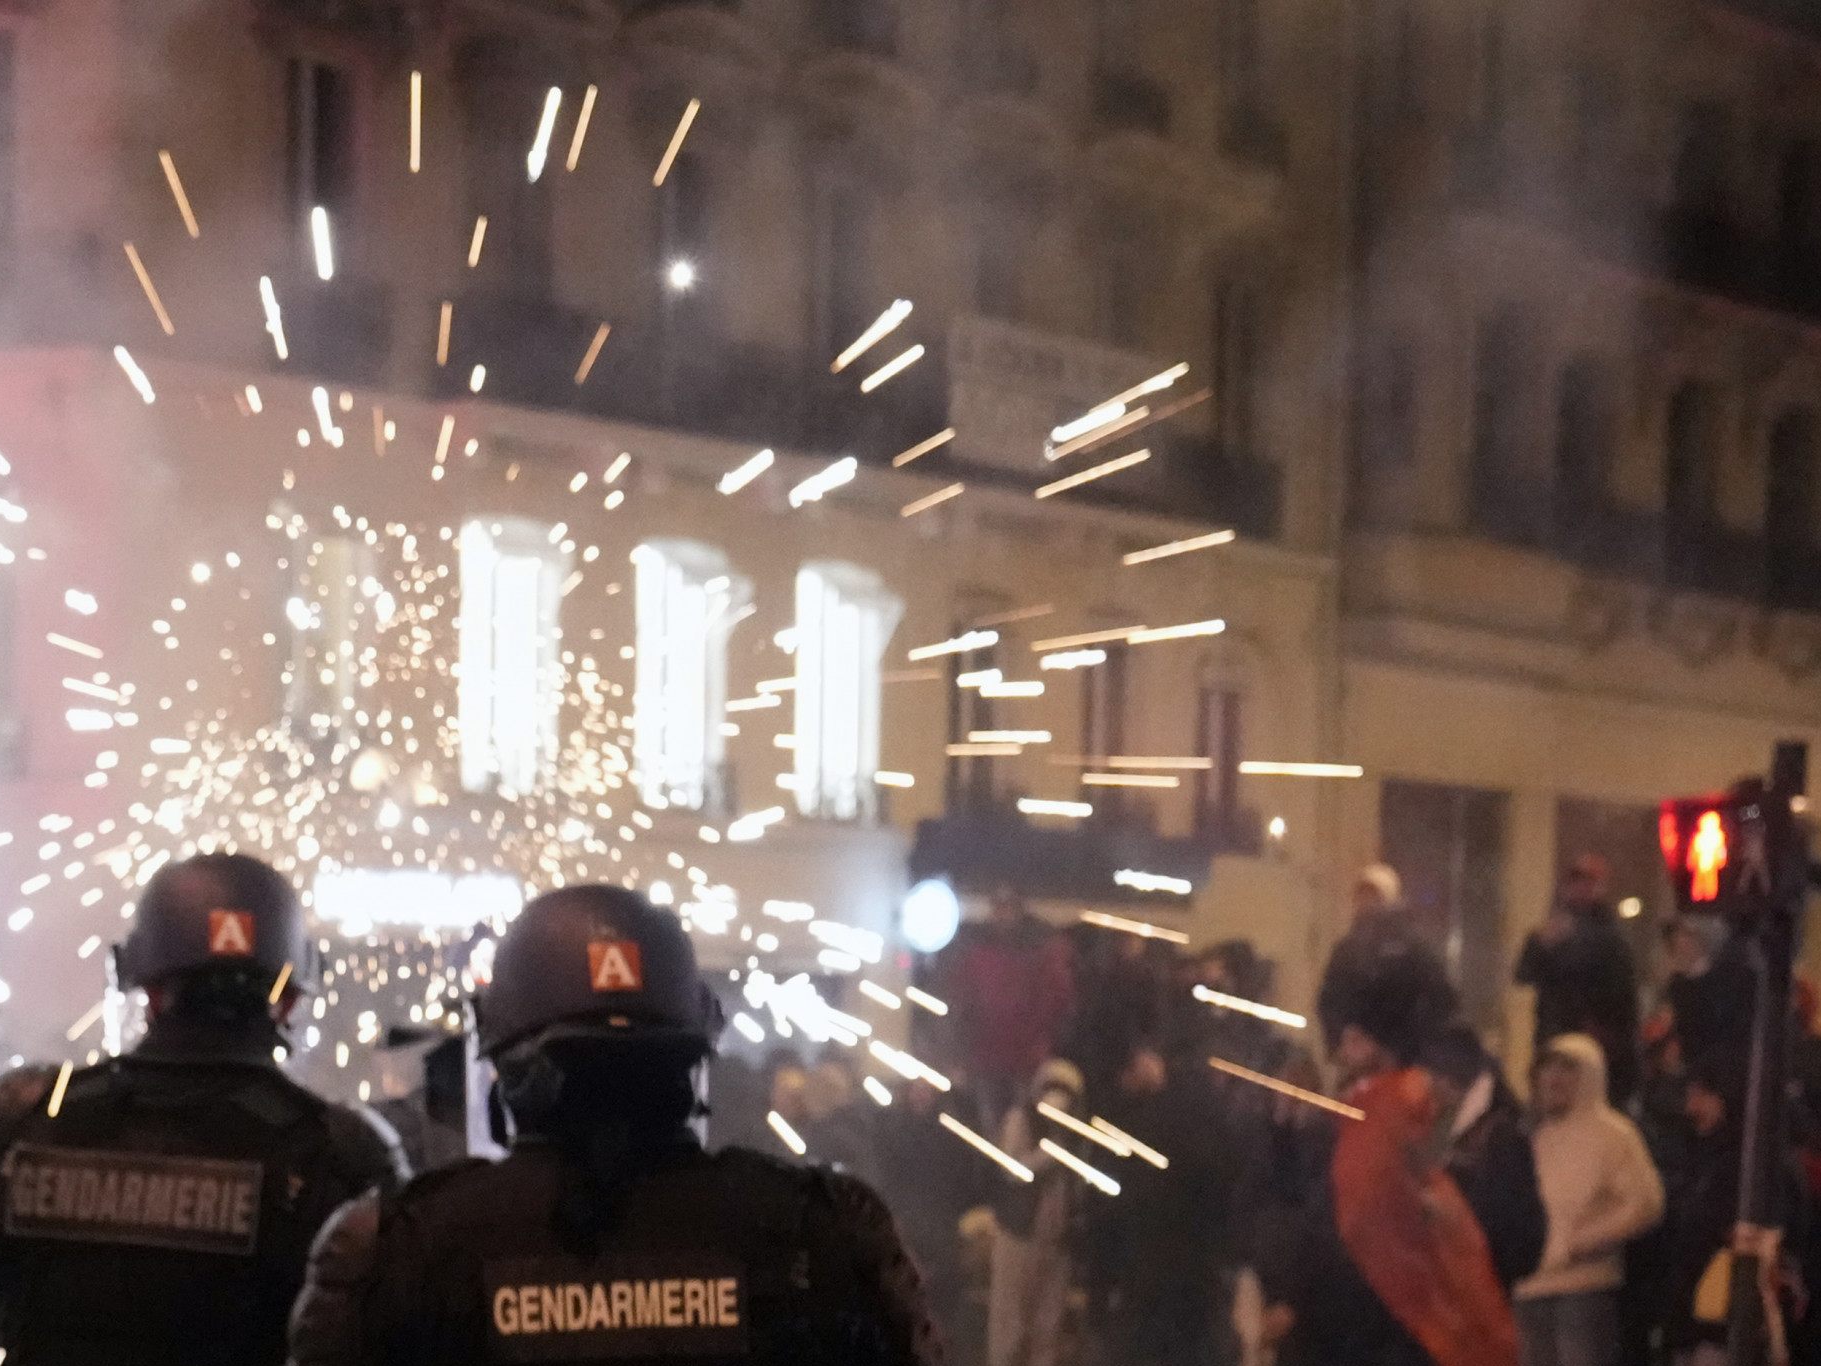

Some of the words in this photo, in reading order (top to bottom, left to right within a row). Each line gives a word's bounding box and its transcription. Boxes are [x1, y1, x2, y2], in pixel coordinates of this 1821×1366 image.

[212, 911, 249, 952] A
[596, 945, 636, 988] A
[11, 1165, 254, 1233] GENDARMERIE
[493, 1277, 738, 1335] GENDARMERIE
